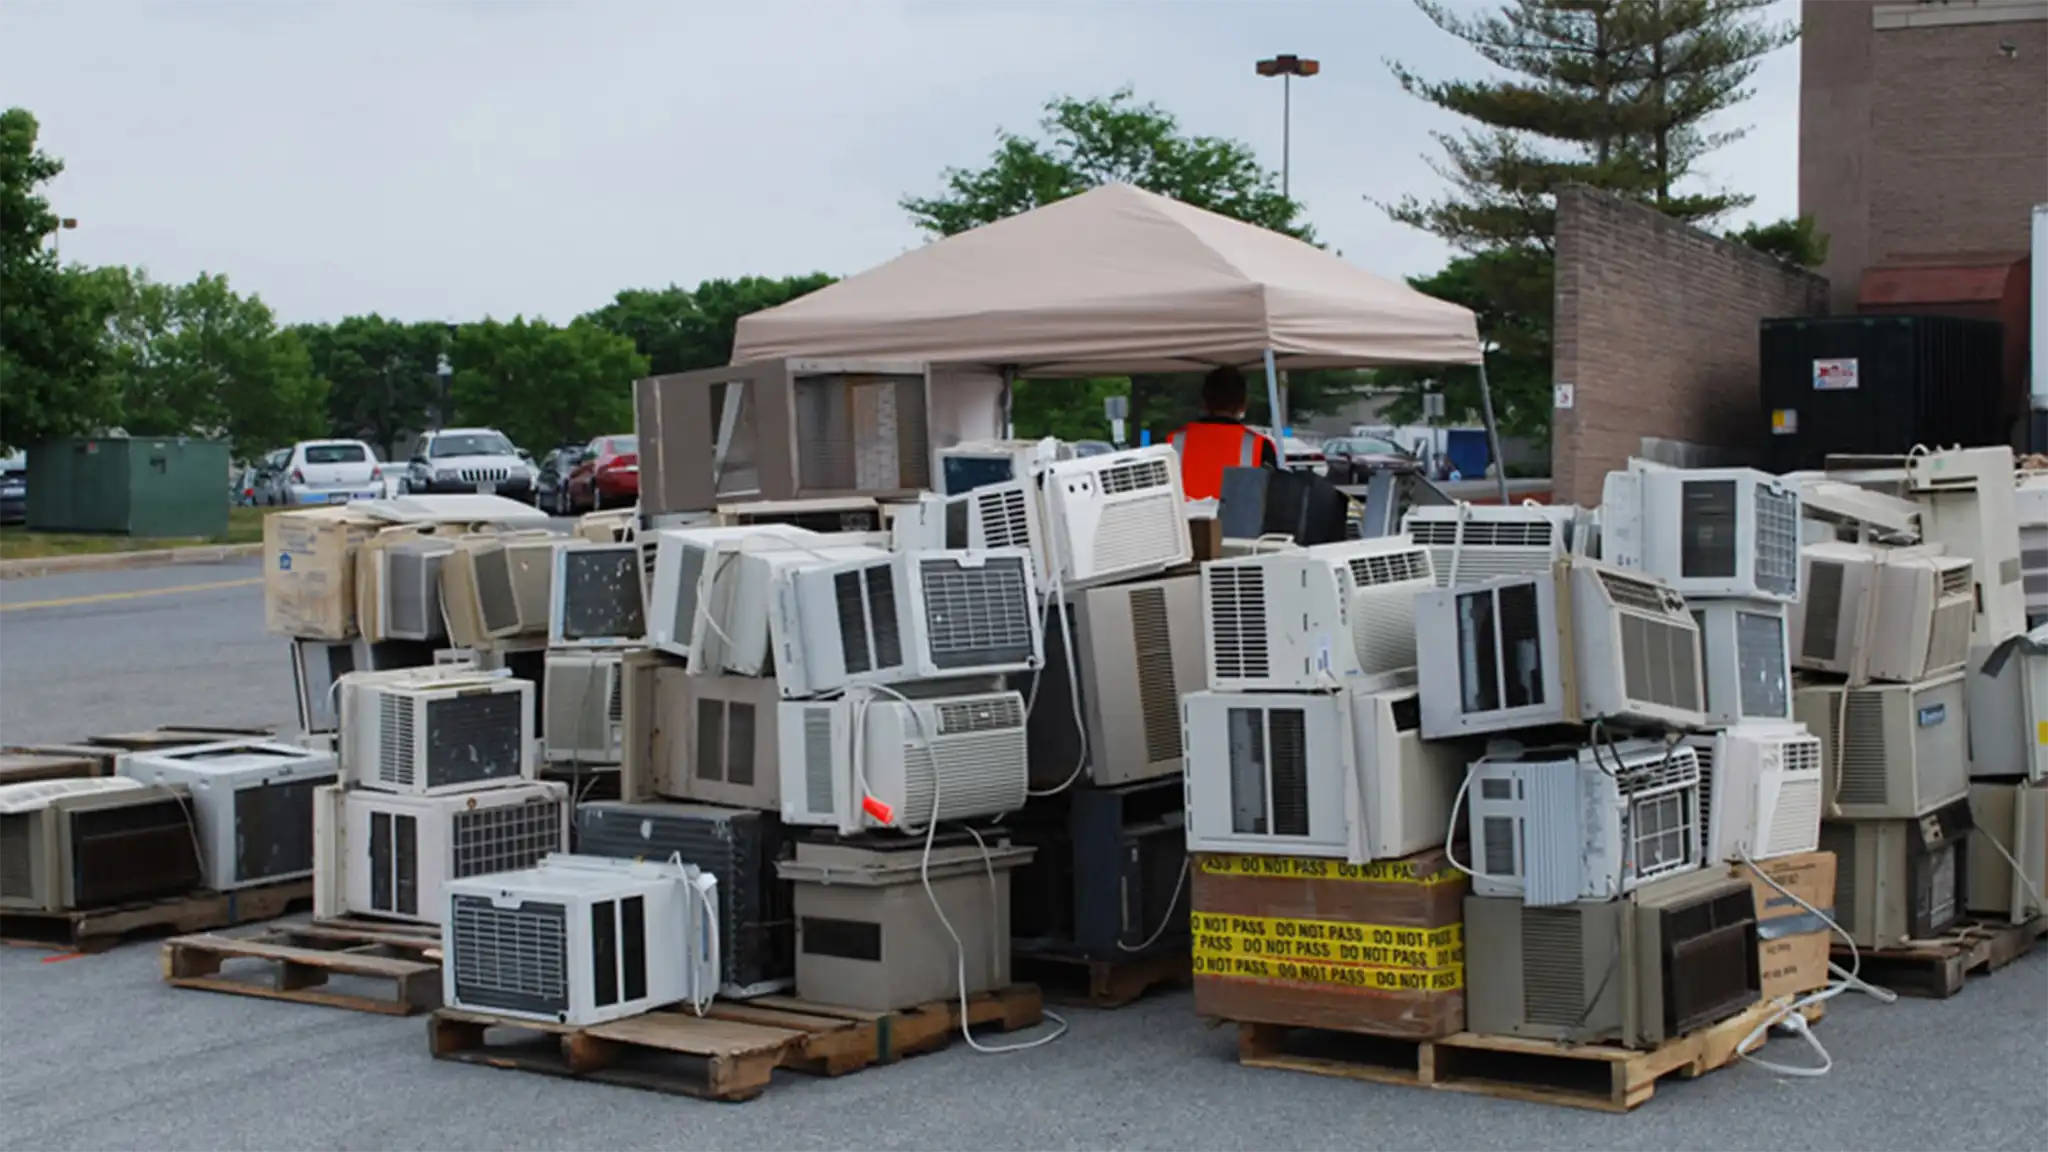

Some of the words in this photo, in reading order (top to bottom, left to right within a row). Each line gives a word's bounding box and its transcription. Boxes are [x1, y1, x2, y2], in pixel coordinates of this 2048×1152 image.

[1241, 857, 1260, 873] DO
[1264, 859, 1290, 873] NOT
[1294, 859, 1328, 876] PASS
[1338, 861, 1358, 876] DO
[1362, 862, 1388, 878] NOT
[1204, 917, 1228, 933] NOT
[1233, 918, 1266, 935] PASS
[1275, 922, 1296, 938] DO
[1299, 923, 1325, 939] NOT
[1329, 925, 1363, 942] PASS
[1373, 929, 1393, 944] DO
[1396, 931, 1424, 947] NOT
[1428, 930, 1452, 949] PASS
[1200, 935, 1233, 951] PASS
[1243, 938, 1262, 953] DO
[1266, 939, 1293, 954] NOT
[1296, 941, 1330, 957] PASS
[1340, 944, 1359, 959] DO
[1363, 946, 1389, 962] NOT
[1393, 948, 1428, 969] PASS
[1208, 957, 1232, 973] NOT
[1236, 959, 1269, 975] PASS
[1278, 963, 1298, 978] DO
[1301, 964, 1326, 982] NOT
[1331, 966, 1366, 985] PASS
[1376, 971, 1396, 986] DO
[1400, 973, 1428, 989] NOT
[1432, 972, 1456, 988] PASS
